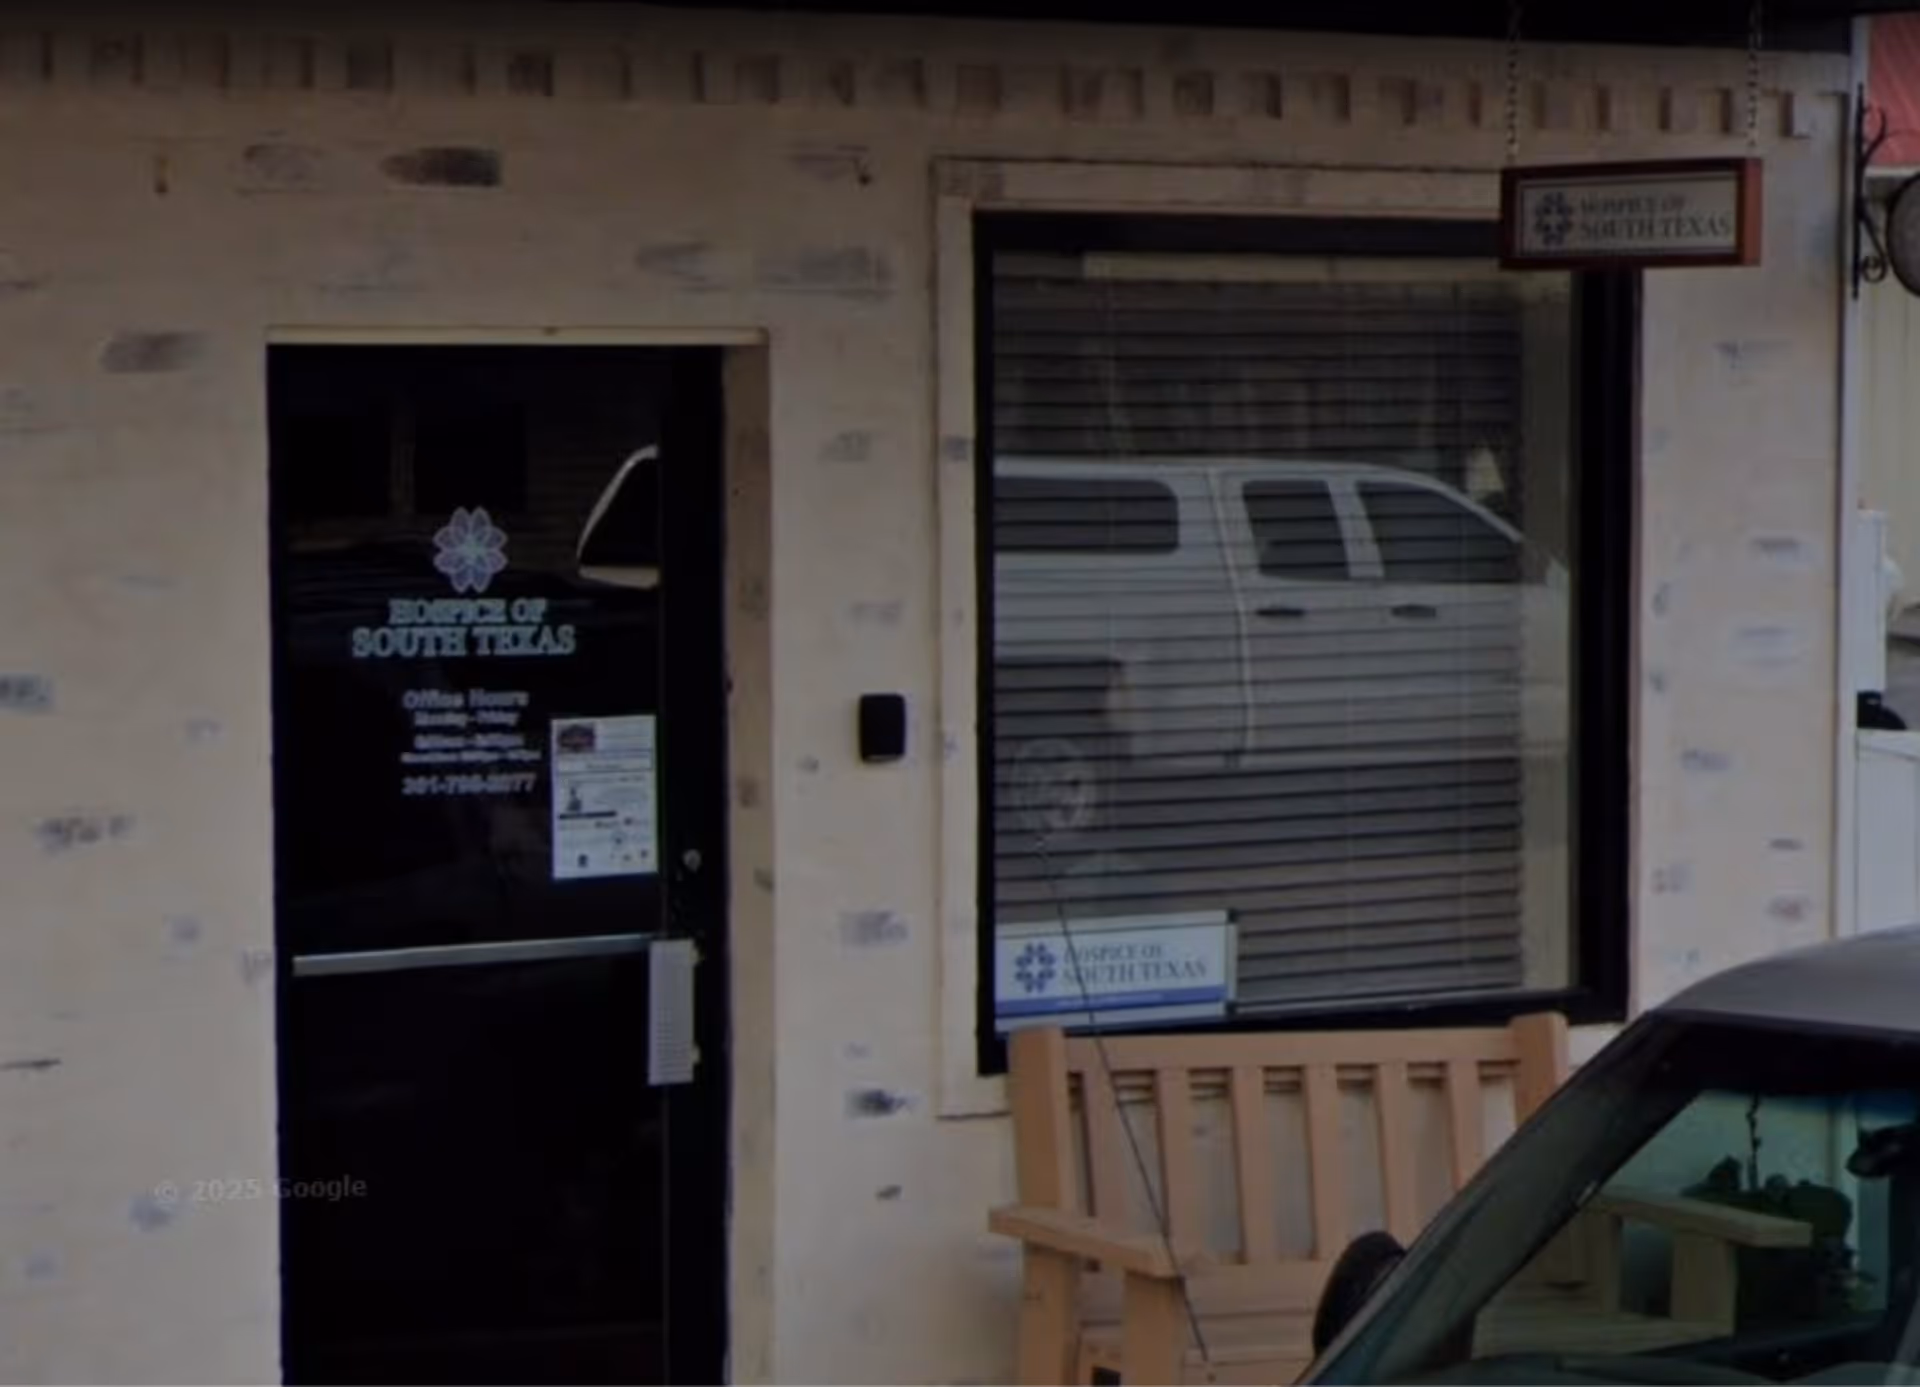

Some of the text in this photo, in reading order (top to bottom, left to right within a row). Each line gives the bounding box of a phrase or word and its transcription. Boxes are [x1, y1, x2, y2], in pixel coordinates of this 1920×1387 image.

[1579, 212, 1732, 240] SOUTH TEXAS
[388, 598, 548, 625] HOSPICE OF
[352, 624, 577, 657] SOUTH TEXAS
[1136, 957, 1208, 982] TEXAS
